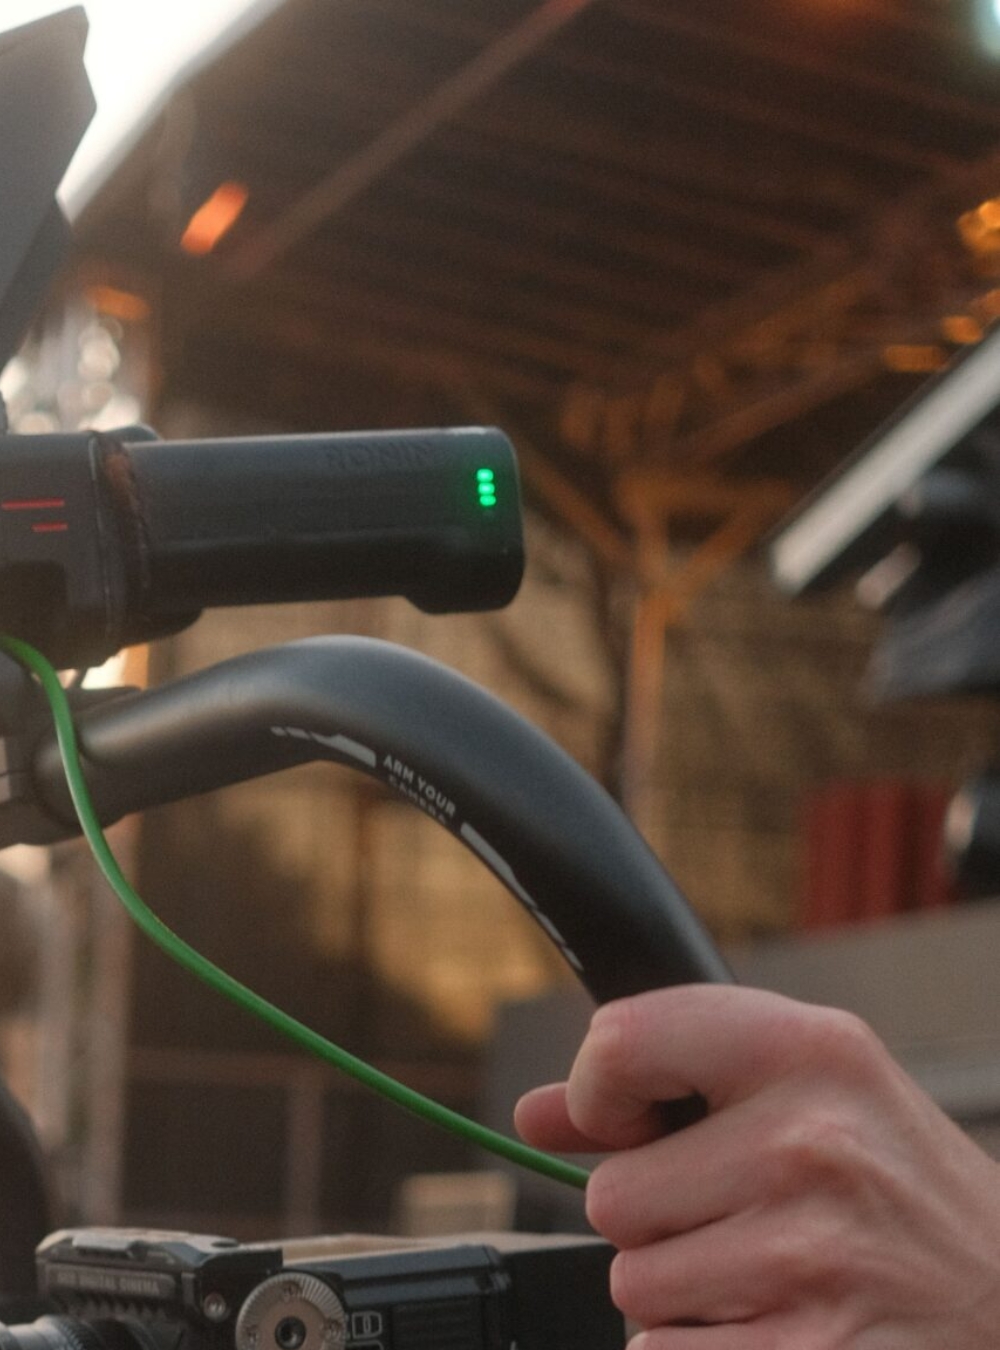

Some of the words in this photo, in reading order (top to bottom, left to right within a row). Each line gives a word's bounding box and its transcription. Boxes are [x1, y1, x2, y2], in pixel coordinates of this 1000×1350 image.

[383, 753, 415, 784] ARM
[416, 775, 457, 819] YOUR
[119, 1276, 160, 1295] CINEMA
